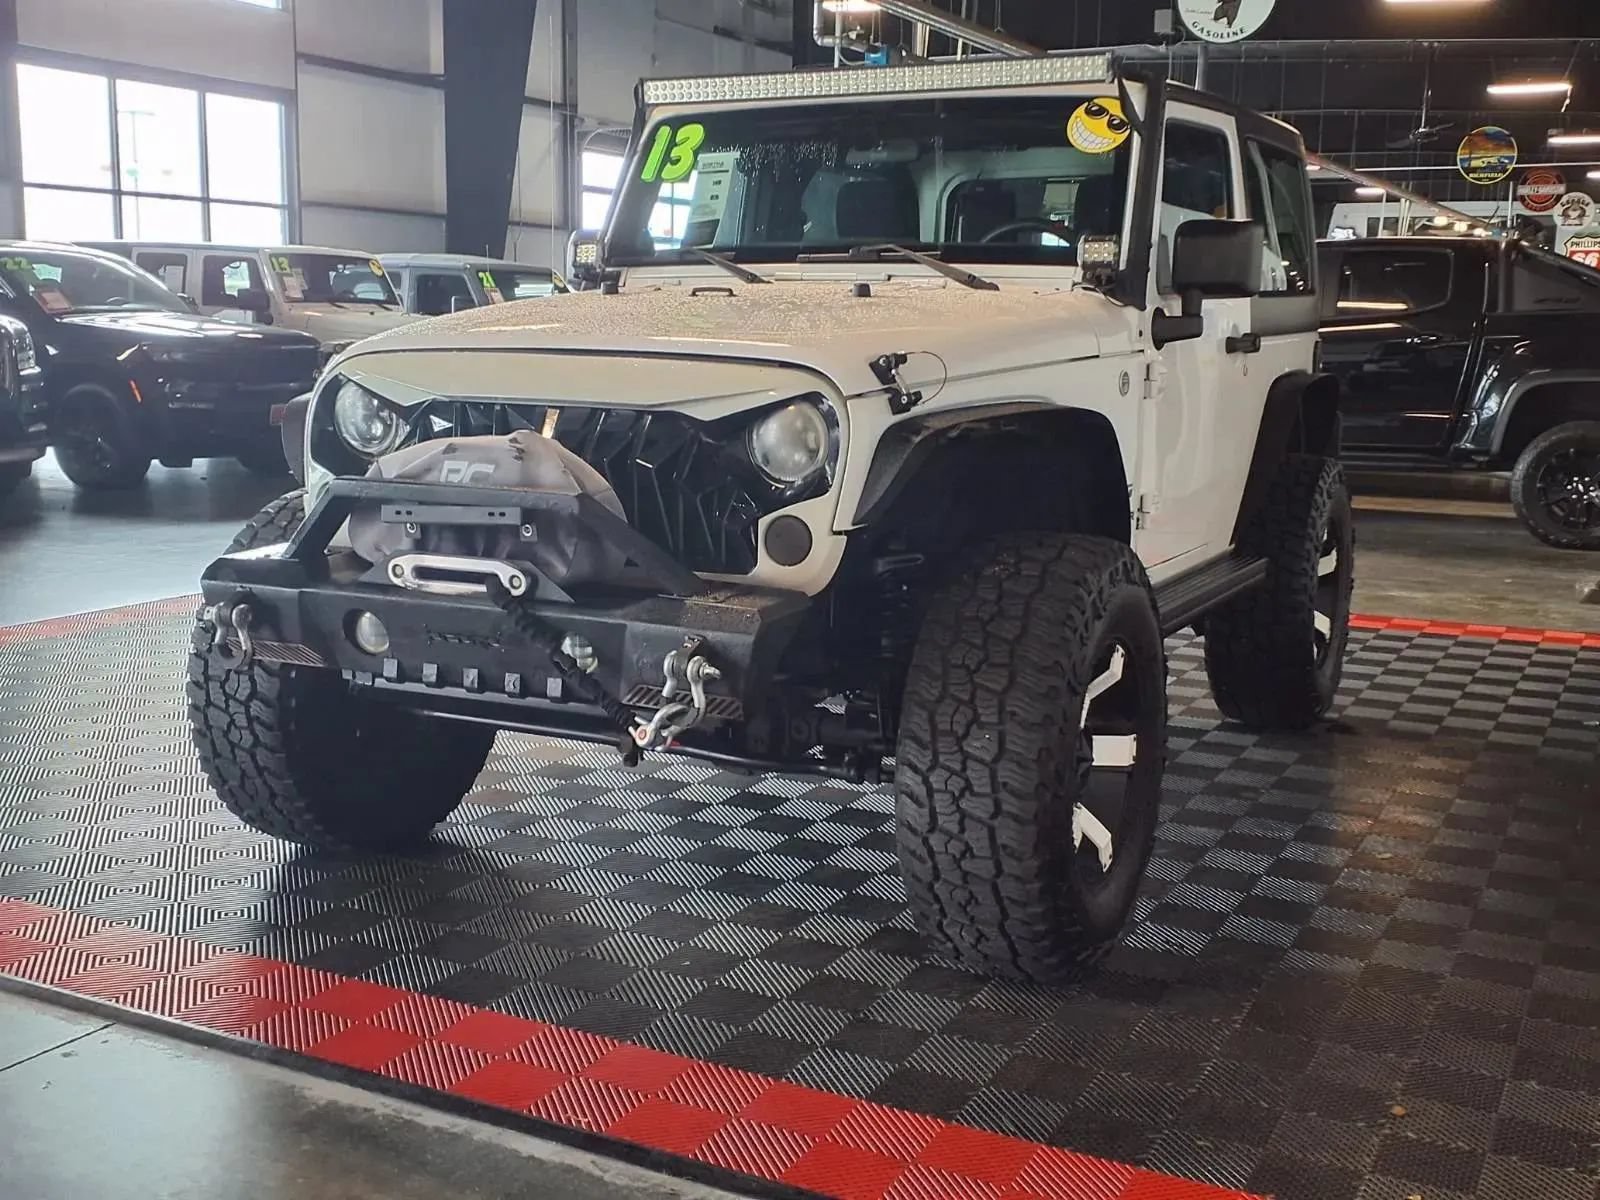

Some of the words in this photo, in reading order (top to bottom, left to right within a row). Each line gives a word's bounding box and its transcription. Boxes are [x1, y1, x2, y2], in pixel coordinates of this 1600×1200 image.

[1192, 20, 1248, 39] GASOLINE
[641, 123, 704, 183] 13
[271, 256, 291, 273] 13
[478, 271, 496, 288] 21
